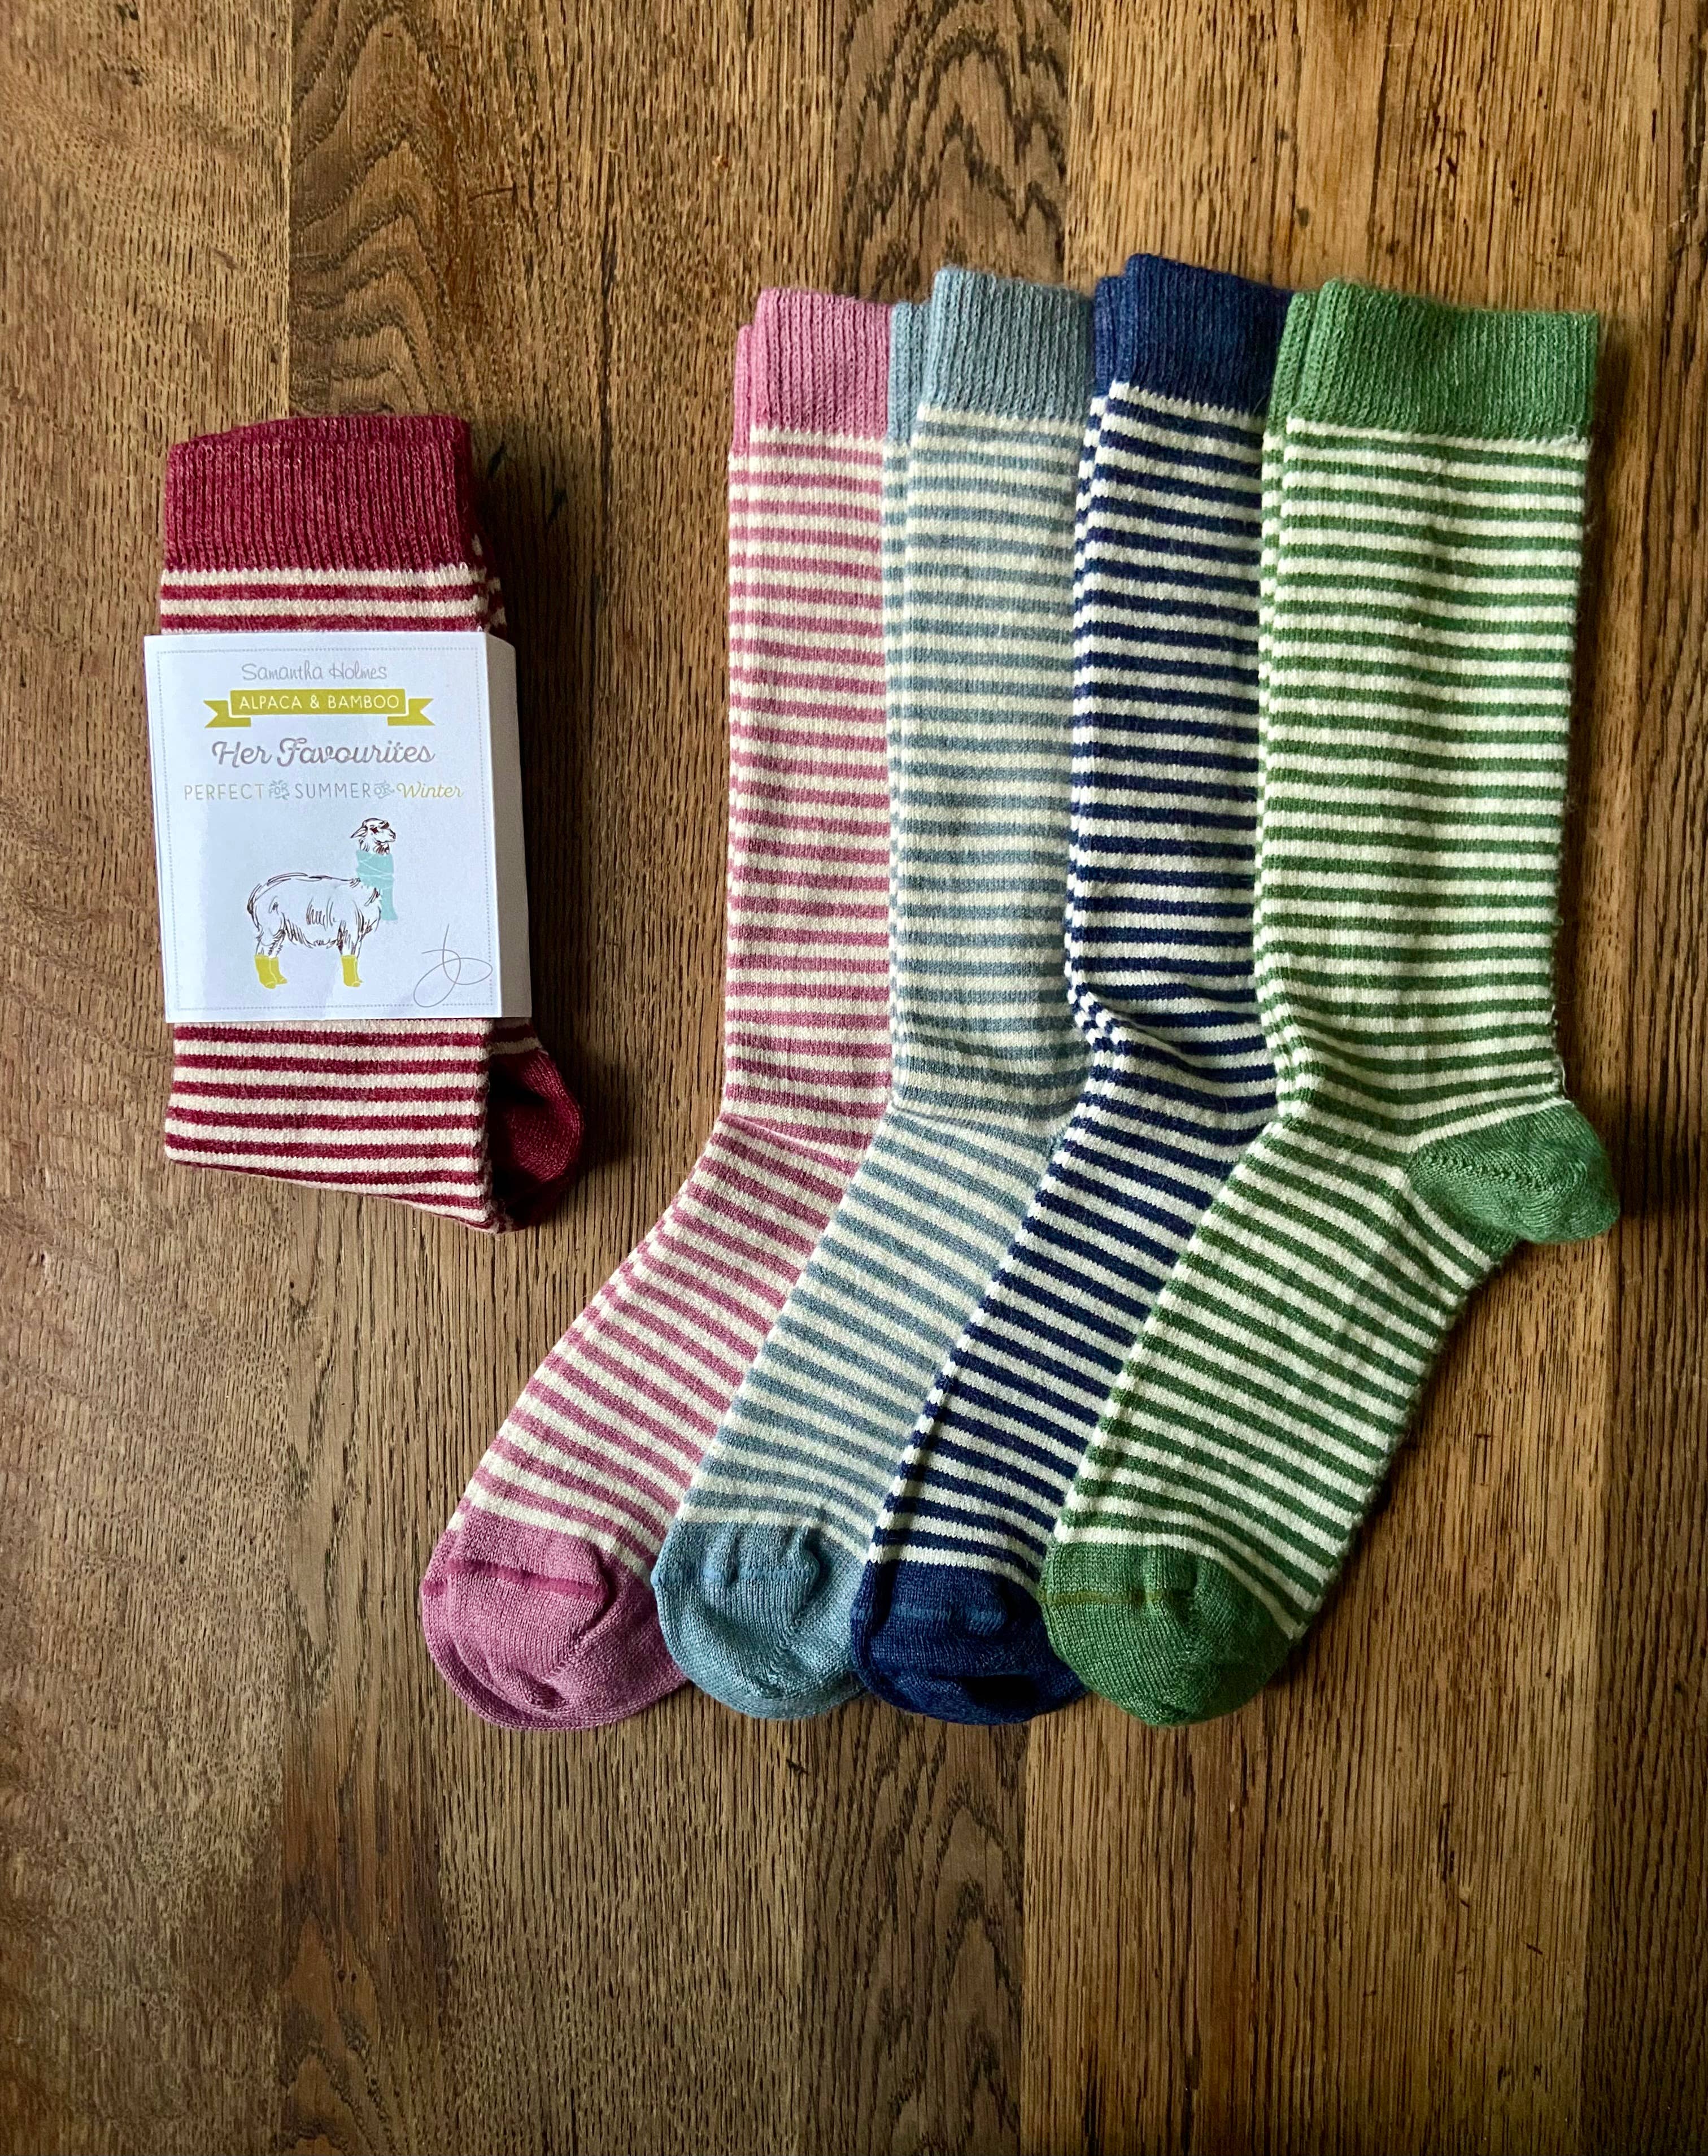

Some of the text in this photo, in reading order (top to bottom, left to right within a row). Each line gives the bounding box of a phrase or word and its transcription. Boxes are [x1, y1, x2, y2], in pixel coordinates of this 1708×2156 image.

[241, 660, 387, 681] Samantha Holmes
[239, 694, 399, 709] ALPACA & BAMBOO
[212, 737, 435, 768] Her Favourites
[184, 783, 264, 800] PERFECT
[268, 782, 290, 798] FOR
[294, 783, 371, 799] SUMMER
[397, 781, 466, 798] Winter
